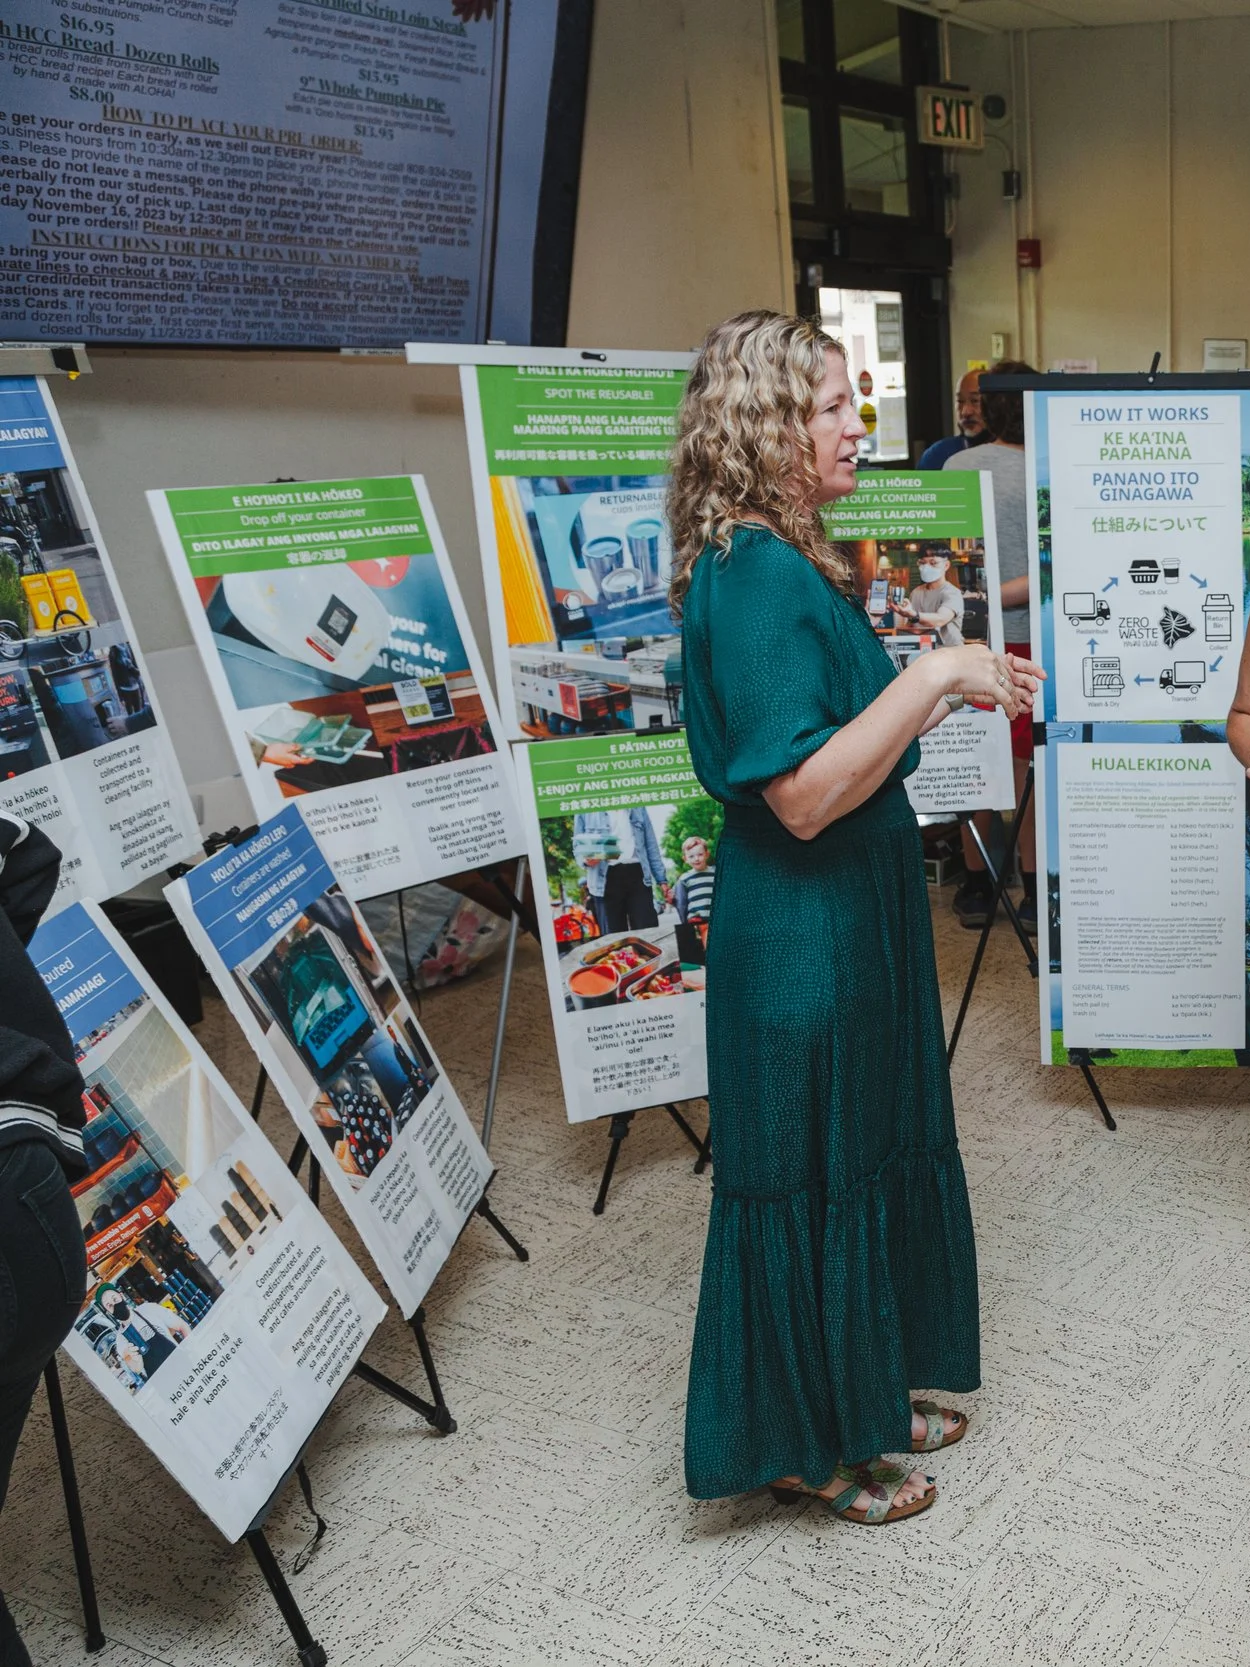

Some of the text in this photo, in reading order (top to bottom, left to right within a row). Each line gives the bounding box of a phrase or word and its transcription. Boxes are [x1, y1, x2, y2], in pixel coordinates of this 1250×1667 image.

[60, 14, 115, 36] $16.95
[401, 11, 429, 27] Loin
[16, 22, 57, 46] HCC
[125, 44, 177, 66] Dozen
[181, 53, 220, 73] Rolls
[69, 85, 115, 104] $8.00
[318, 79, 362, 98] Whole
[366, 88, 423, 108] Pumpkin
[426, 97, 445, 113] Pie
[103, 104, 143, 123] HOW
[152, 111, 174, 127] TO
[932, 96, 975, 140] EXIT
[11, 112, 36, 127] get
[40, 116, 74, 131] your
[79, 121, 125, 138] orders
[129, 125, 142, 138] in
[185, 136, 201, 147] as
[204, 138, 223, 149] we
[225, 138, 248, 151] sell
[251, 142, 271, 153] out
[274, 142, 315, 160] EVERY
[544, 388, 653, 400] SPOT THE REUSABLE!
[527, 414, 581, 425] HANAPIN
[584, 415, 608, 425] ANG
[1080, 407, 1209, 421] HOW IT WORKS
[0, 427, 48, 441] ALAGYAN
[513, 425, 662, 435] MAARING PANG GAMITING
[1104, 432, 1123, 445] KE
[1100, 447, 1192, 461] PAPAHANA
[879, 477, 922, 487] I HŌKEO
[1092, 472, 1199, 486] PANANO ITO
[232, 496, 241, 507] E
[304, 491, 321, 503] KA
[850, 494, 870, 503] OUT
[872, 494, 880, 502] A
[882, 493, 936, 503] CONTAINER
[1100, 487, 1193, 501] GINAGAWA
[240, 507, 367, 526] Drop off your container
[611, 506, 632, 514] cups
[884, 510, 936, 519] LALAGYAN
[1092, 516, 1207, 533] 仕組みについて
[192, 524, 419, 553] DITO ILAGAY ANG INYONG MGA LALAGYAN
[1118, 617, 1149, 628] ZERO
[1118, 628, 1158, 639] WASTE
[423, 643, 447, 664] for
[956, 722, 972, 730] your
[93, 744, 140, 768] Containers are
[610, 744, 616, 754] E
[576, 755, 685, 775] ENJOY YOUR FOOD &
[1091, 758, 1212, 771] HUALEKIKONA
[406, 764, 493, 789] Return your containers
[537, 771, 697, 796] I-ENJOY ANG IYONG PAGKAIN
[232, 871, 261, 897] Containers
[260, 864, 271, 876] are
[594, 1024, 613, 1032] lawe
[615, 1021, 630, 1029] aku
[255, 1241, 295, 1289] Containers are
[262, 1248, 304, 1300] redistributed at
[258, 1245, 322, 1328] participating restaurants
[269, 1256, 327, 1333] and cafes around town!
[184, 1376, 195, 1387] ka
[193, 1349, 218, 1376] hōkeo
[204, 1374, 230, 1405] kaona!
